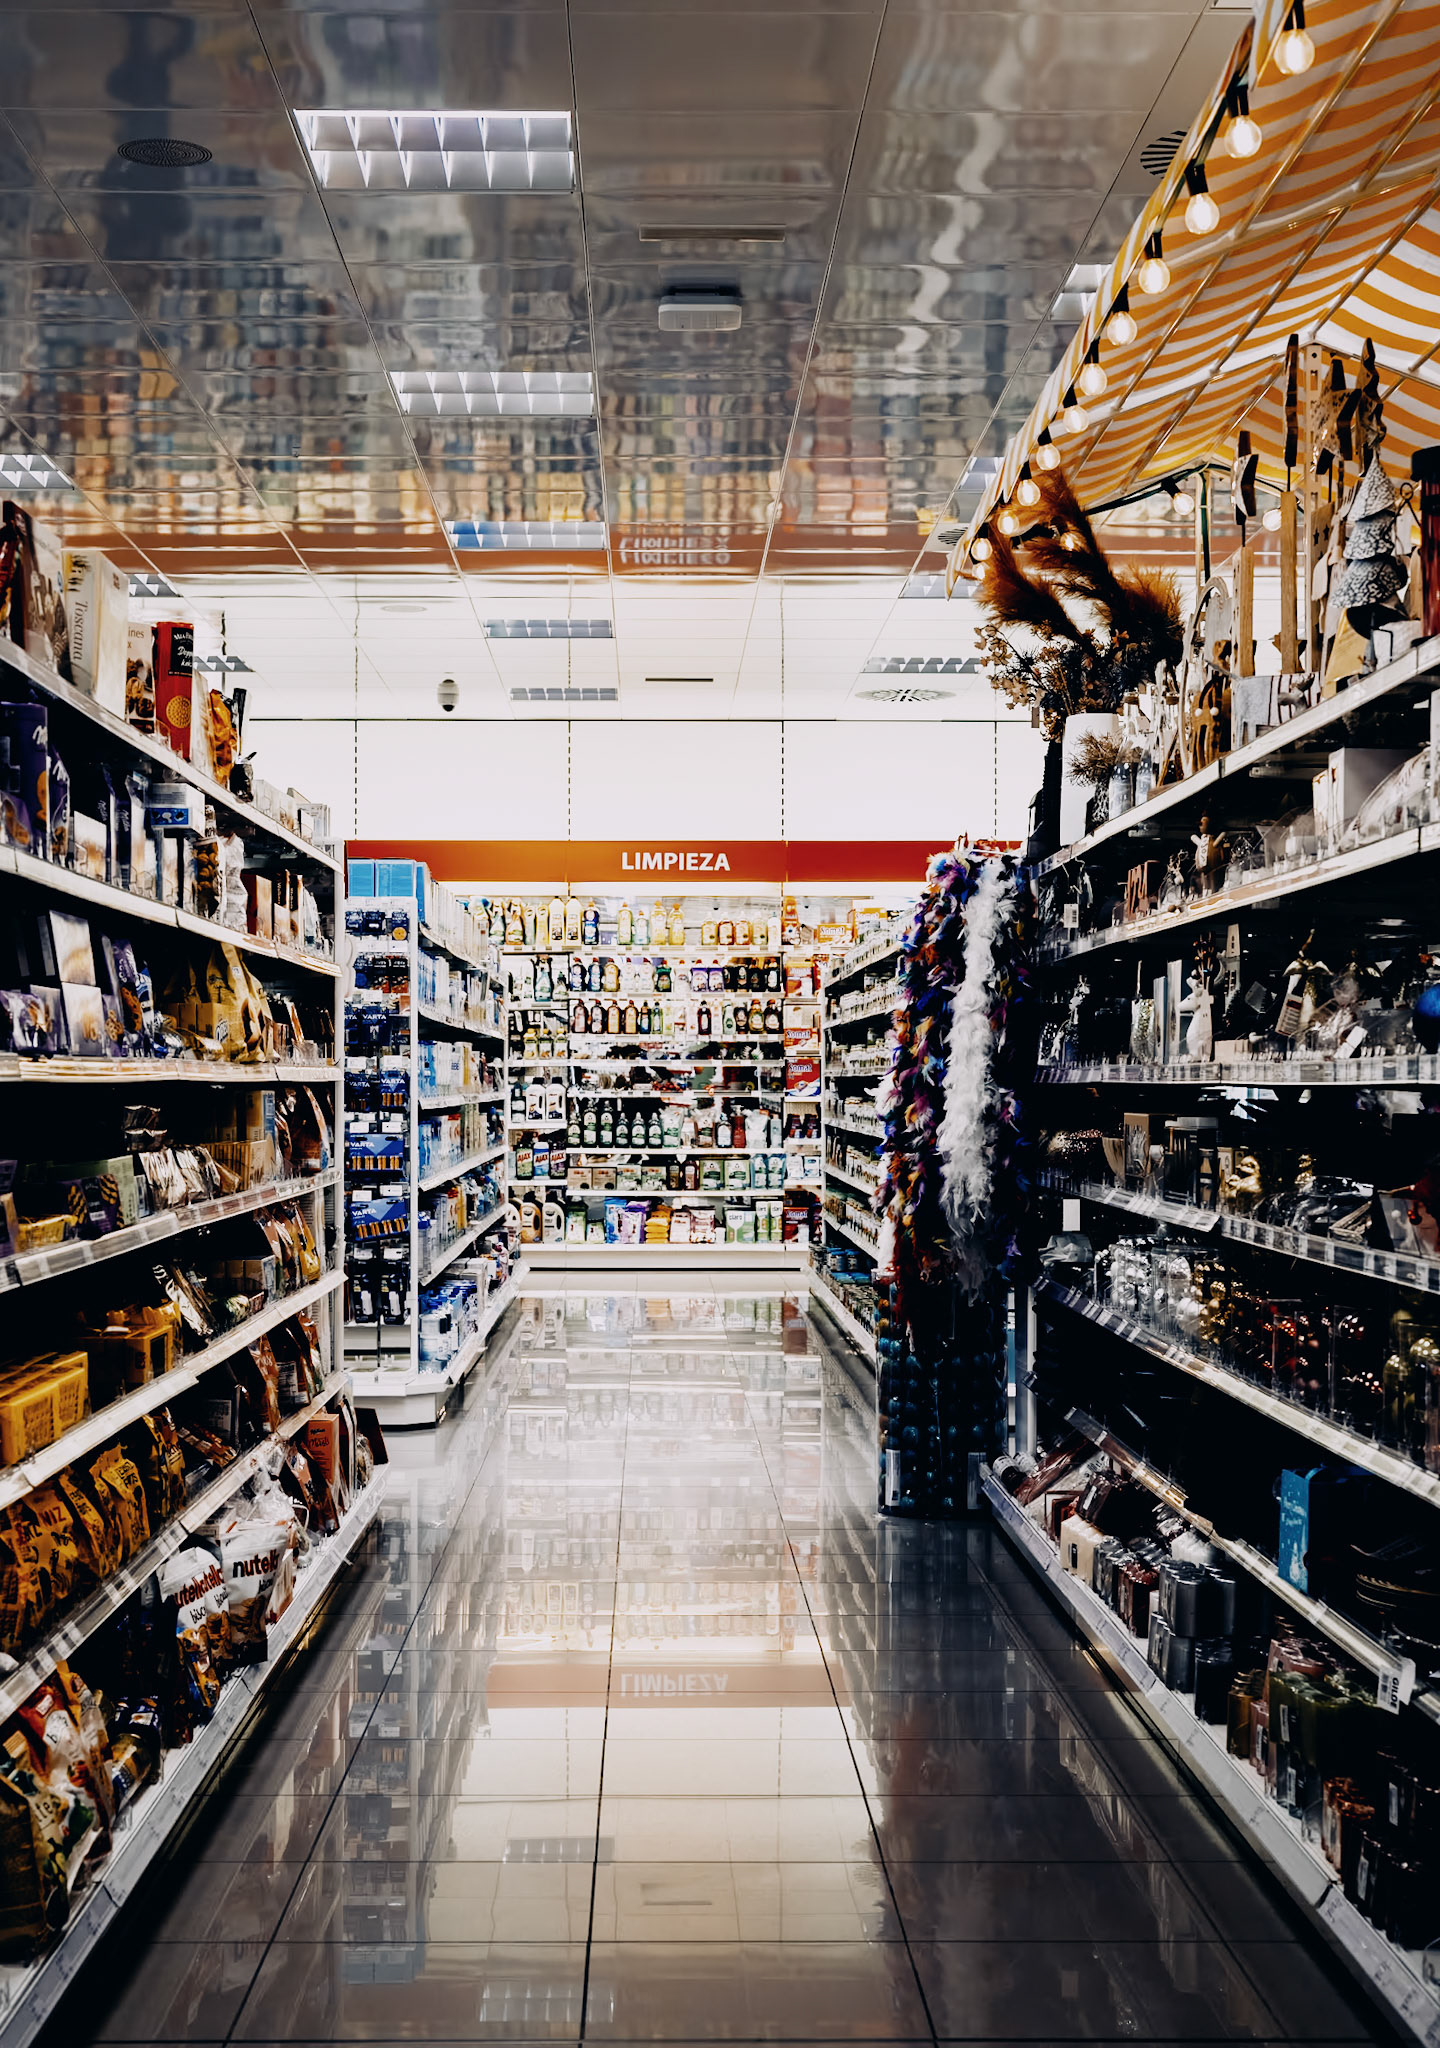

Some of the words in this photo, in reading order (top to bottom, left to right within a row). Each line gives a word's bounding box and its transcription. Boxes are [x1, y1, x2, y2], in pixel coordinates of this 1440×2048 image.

[73, 601, 89, 660] Toscana
[621, 851, 731, 871] LIMPIEZA
[786, 1029, 812, 1039] Somat
[788, 1062, 813, 1073] Somat
[517, 1152, 531, 1162] AJAX
[535, 1154, 548, 1163] AJAX
[551, 1152, 565, 1161] AJAX
[352, 1208, 377, 1217] VARTA
